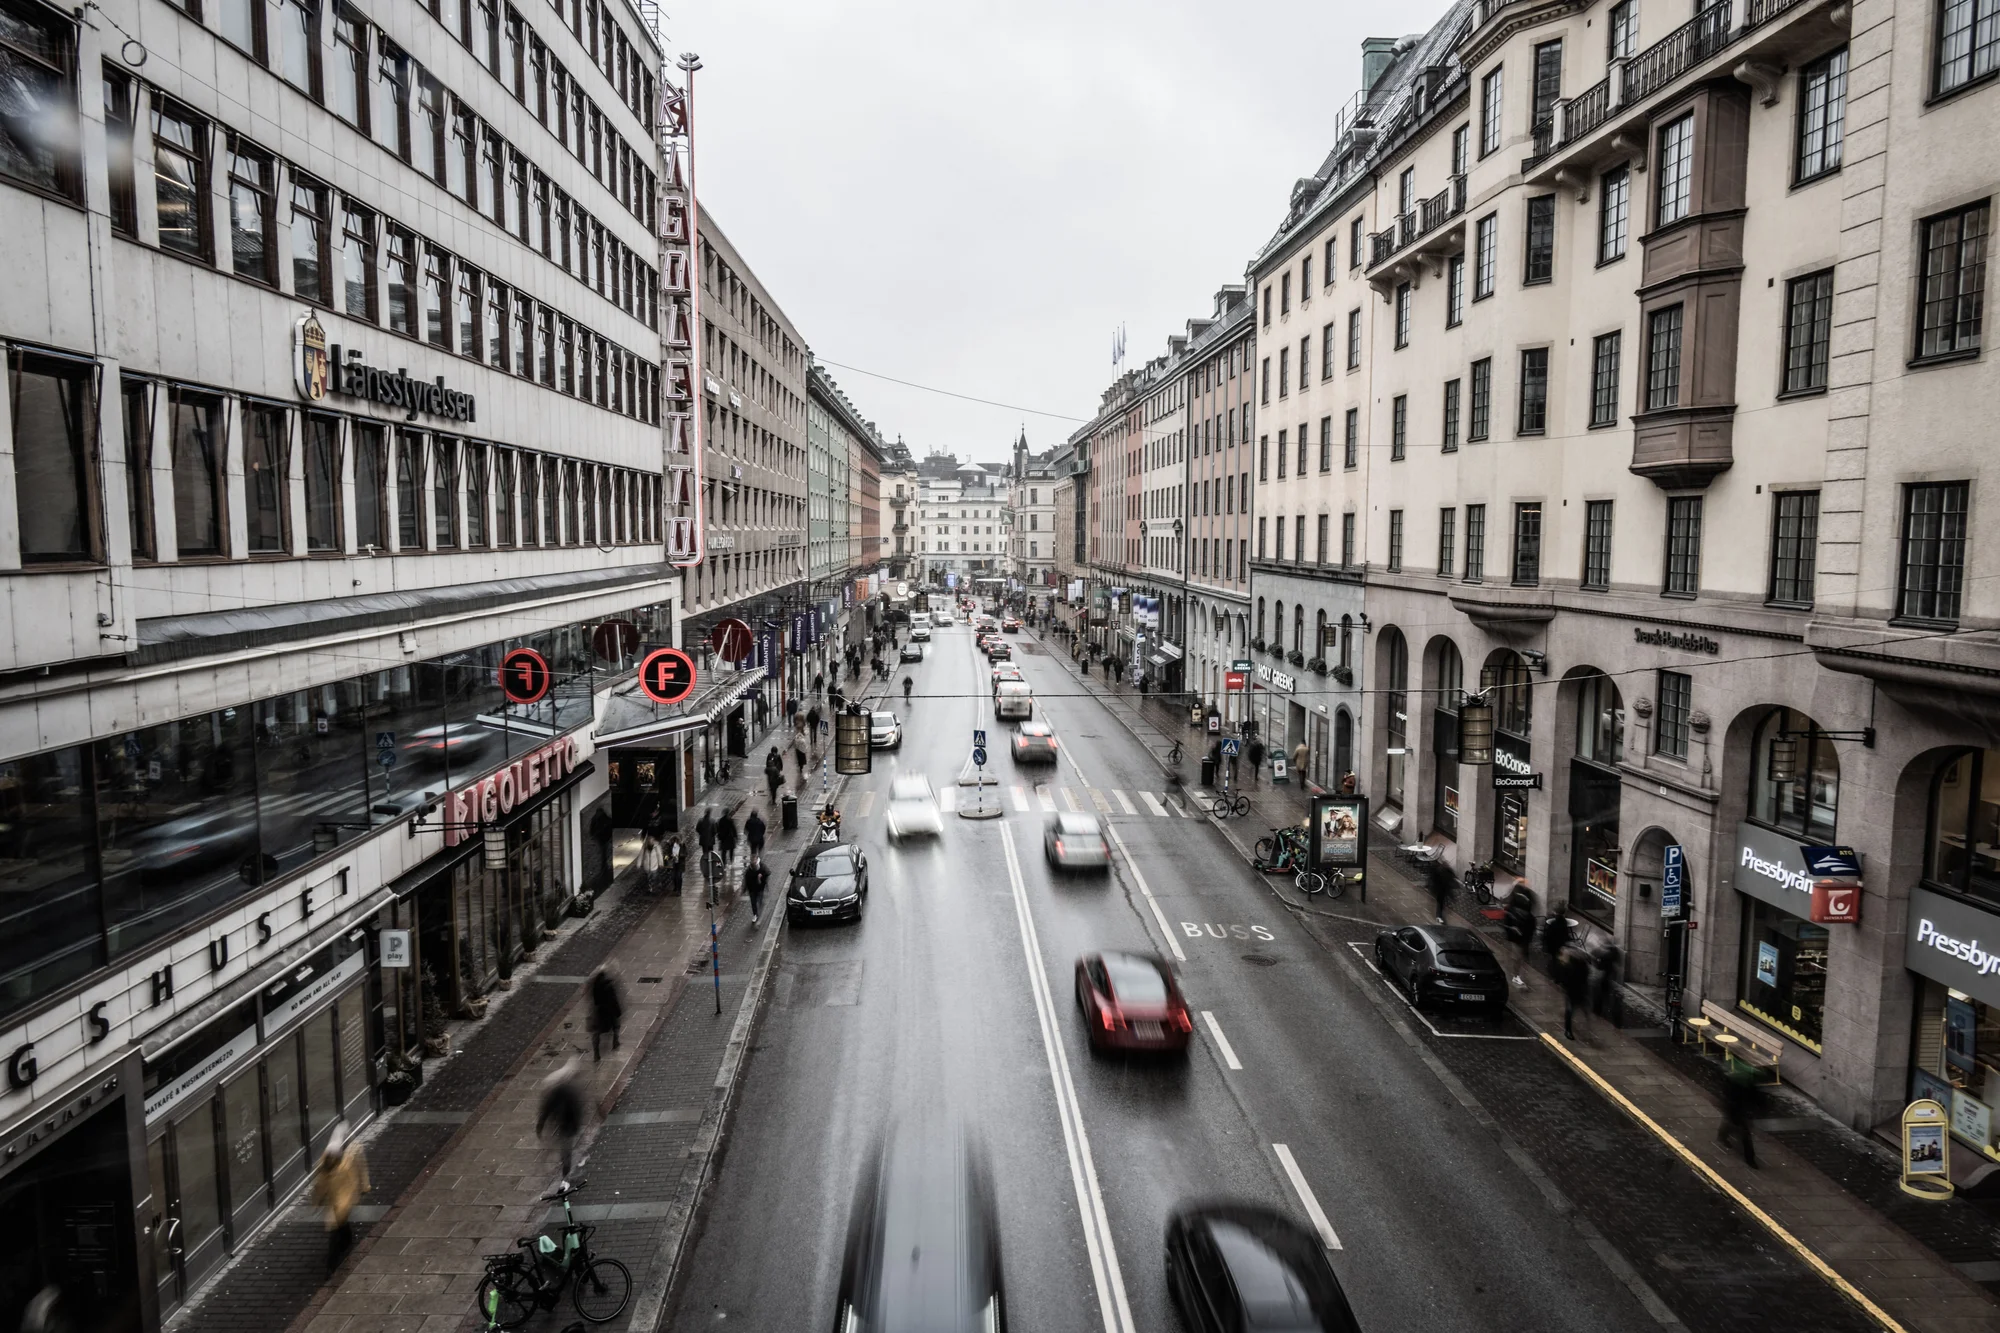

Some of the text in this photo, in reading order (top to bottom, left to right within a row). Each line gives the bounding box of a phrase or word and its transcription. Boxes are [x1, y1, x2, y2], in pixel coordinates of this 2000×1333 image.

[657, 79, 691, 558] RIGOLETTO
[331, 344, 476, 422] Länsstyrelsen
[658, 661, 678, 691] F
[1258, 663, 1294, 693] HOLY GREENS
[1495, 747, 1531, 775] BoConce
[446, 736, 576, 846] RIGOLETTO
[1495, 778, 1535, 787] BoConcept
[1669, 847, 1680, 864] P
[1741, 846, 1814, 894] Pressbyrån
[1180, 921, 1275, 941] BUSS
[1917, 918, 2000, 975] Pressbyr
[291, 971, 342, 1011] NO WORK AND ALL PLAY
[145, 1090, 174, 1116] MATKAFÉ
[181, 1049, 234, 1092] MUSIKINTERMEZZO
